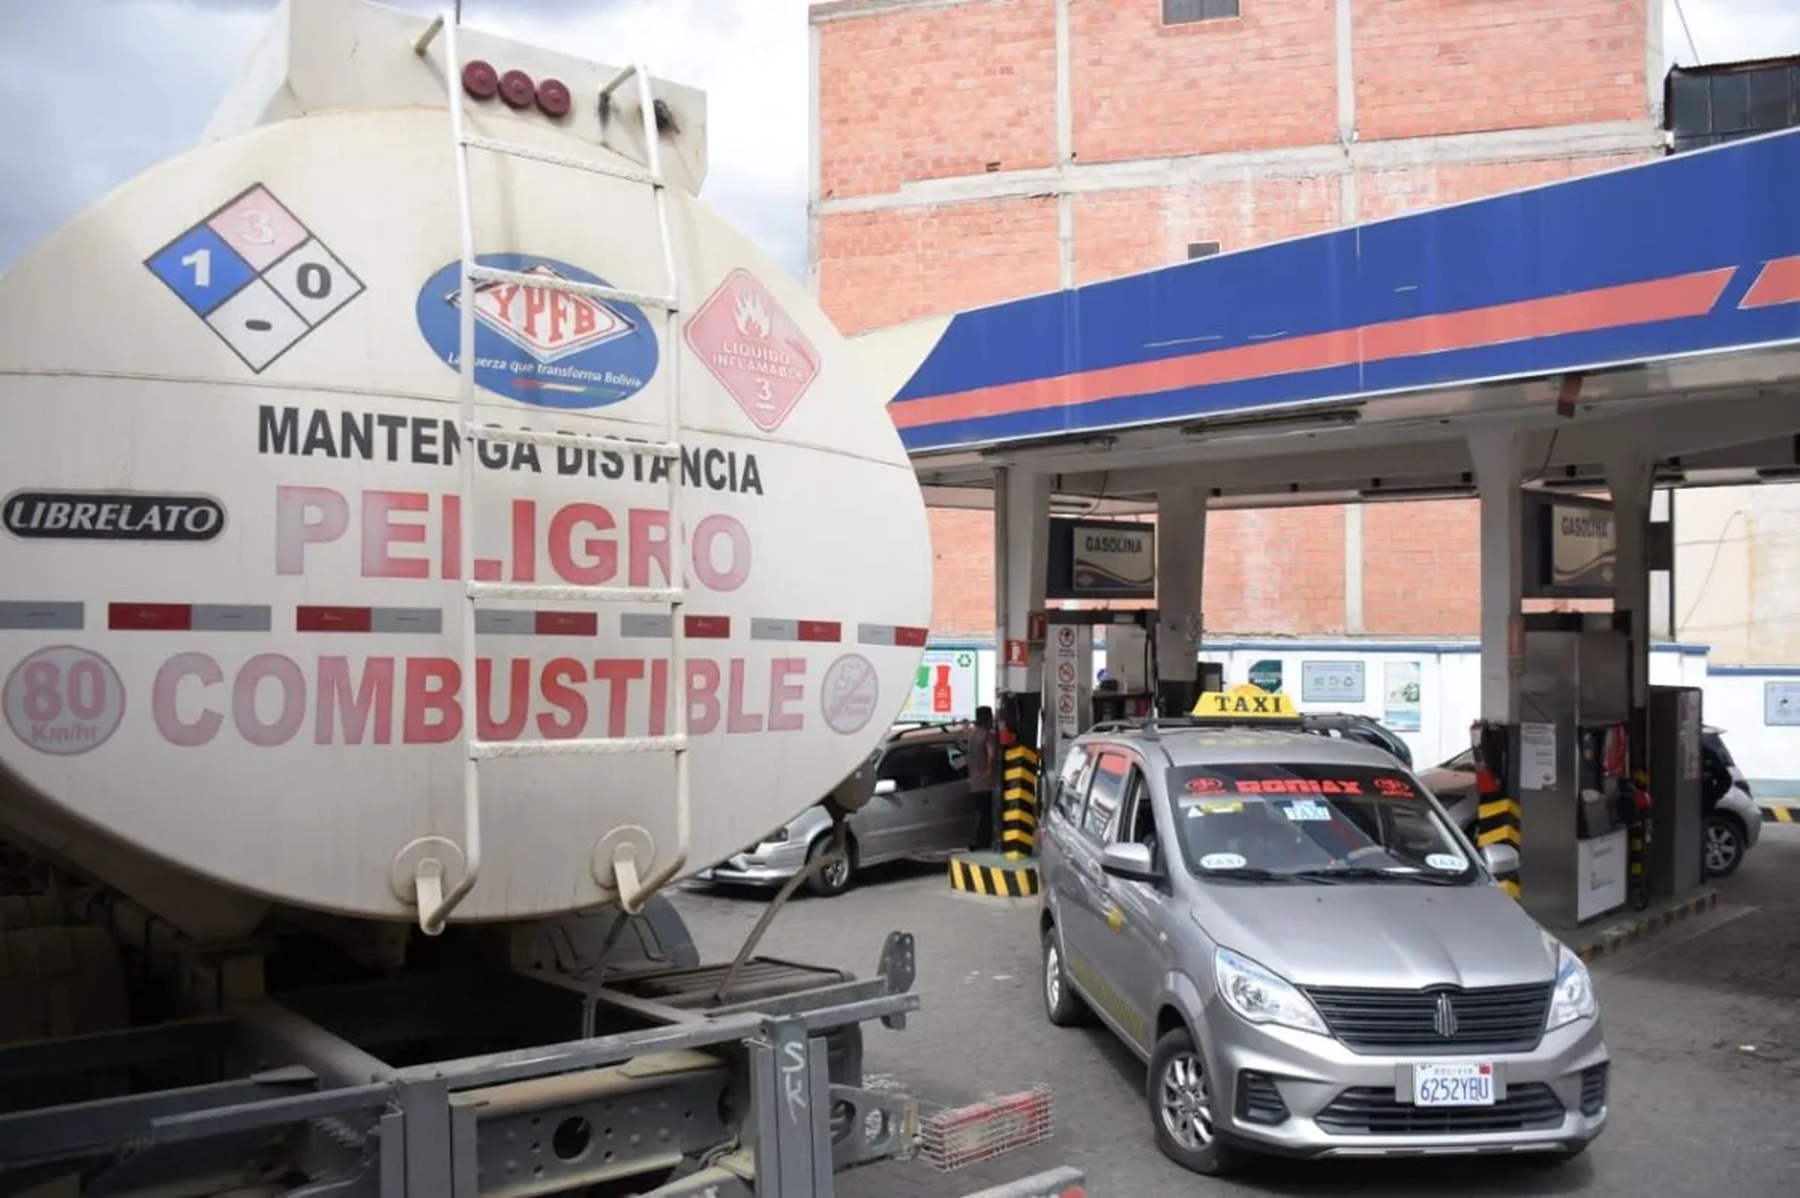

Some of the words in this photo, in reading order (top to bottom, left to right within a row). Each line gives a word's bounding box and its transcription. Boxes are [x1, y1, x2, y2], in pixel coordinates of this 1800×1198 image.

[181, 248, 211, 288] 1
[296, 262, 332, 300] 0
[490, 284, 596, 343] YPFB
[510, 360, 535, 374] que
[537, 362, 603, 382] transforma
[604, 371, 643, 388] Bolivia
[754, 376, 773, 401] 3
[259, 405, 542, 473] MANTENGA
[9, 500, 219, 533] LIBRELATO
[275, 485, 753, 593] PELIGRO
[1085, 535, 1142, 553] GASOLINA
[22, 658, 107, 722] 80
[151, 650, 807, 748] COMBUSTIBLE
[1214, 695, 1281, 713] TAXI
